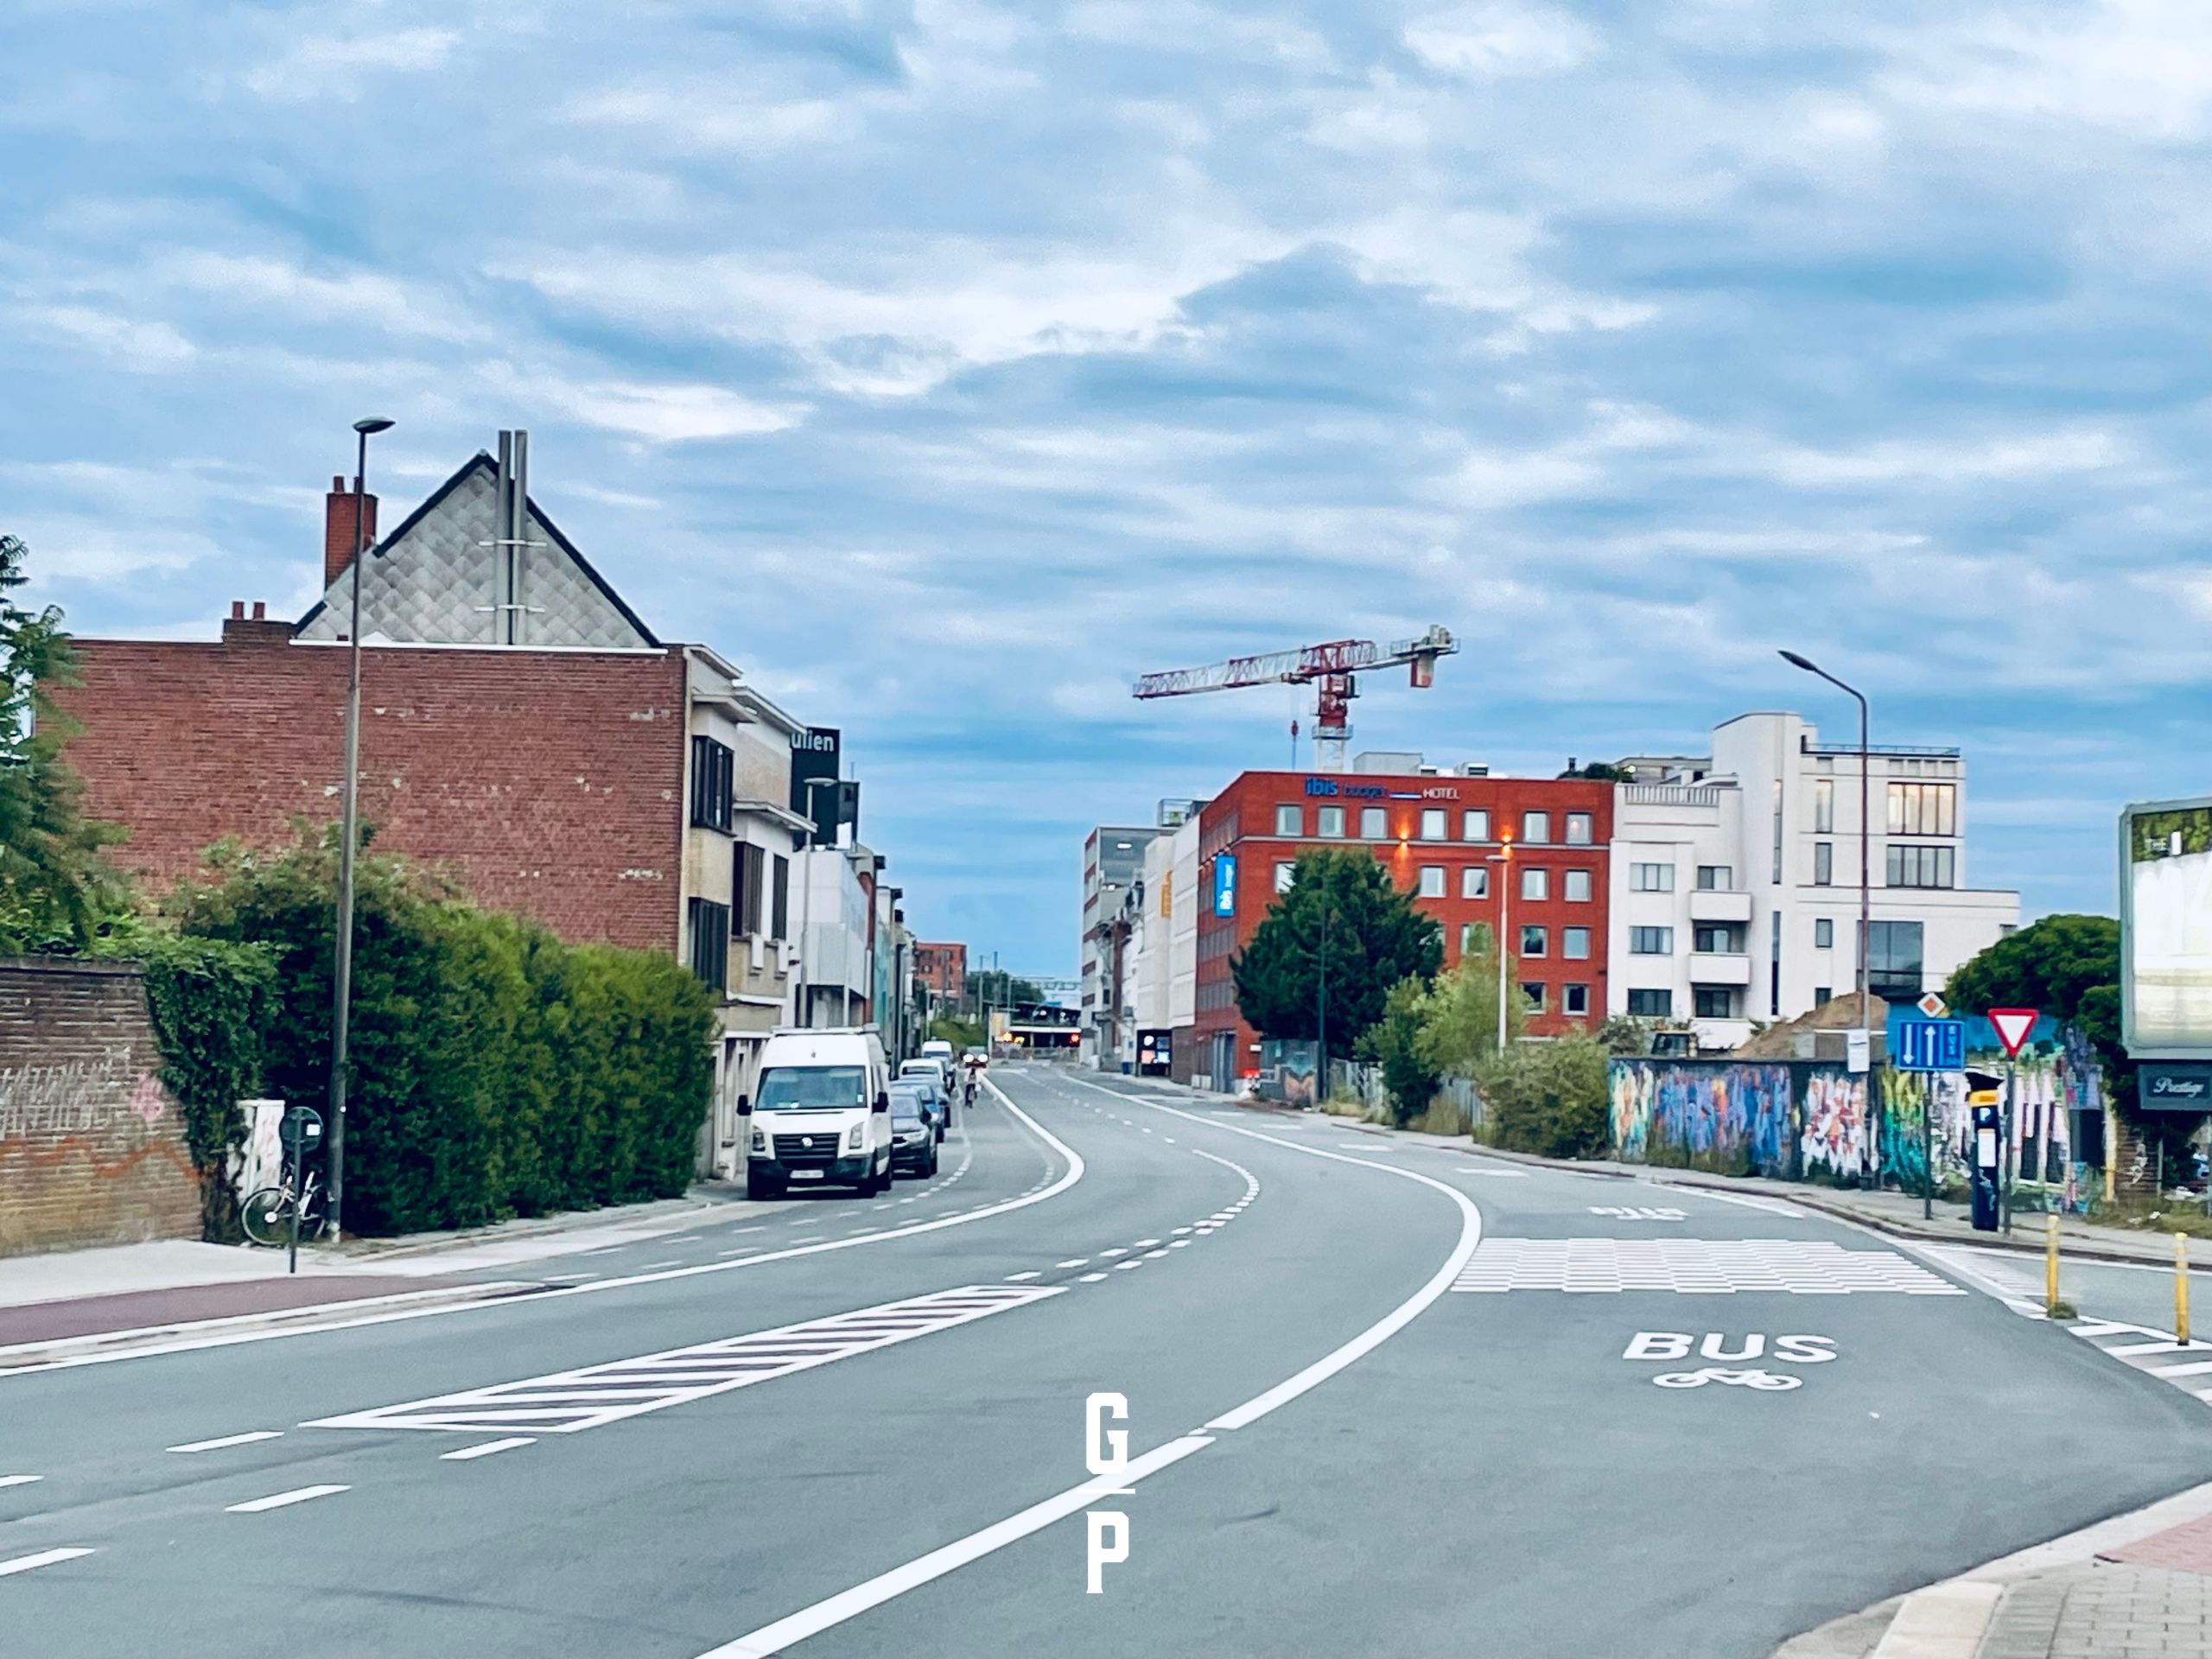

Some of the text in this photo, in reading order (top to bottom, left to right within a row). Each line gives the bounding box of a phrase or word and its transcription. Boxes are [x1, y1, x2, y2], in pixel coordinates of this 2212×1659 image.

[1306, 778, 1338, 796] ibis
[1423, 787, 1460, 799] HOTEL
[1622, 1332, 1838, 1363] BUS
